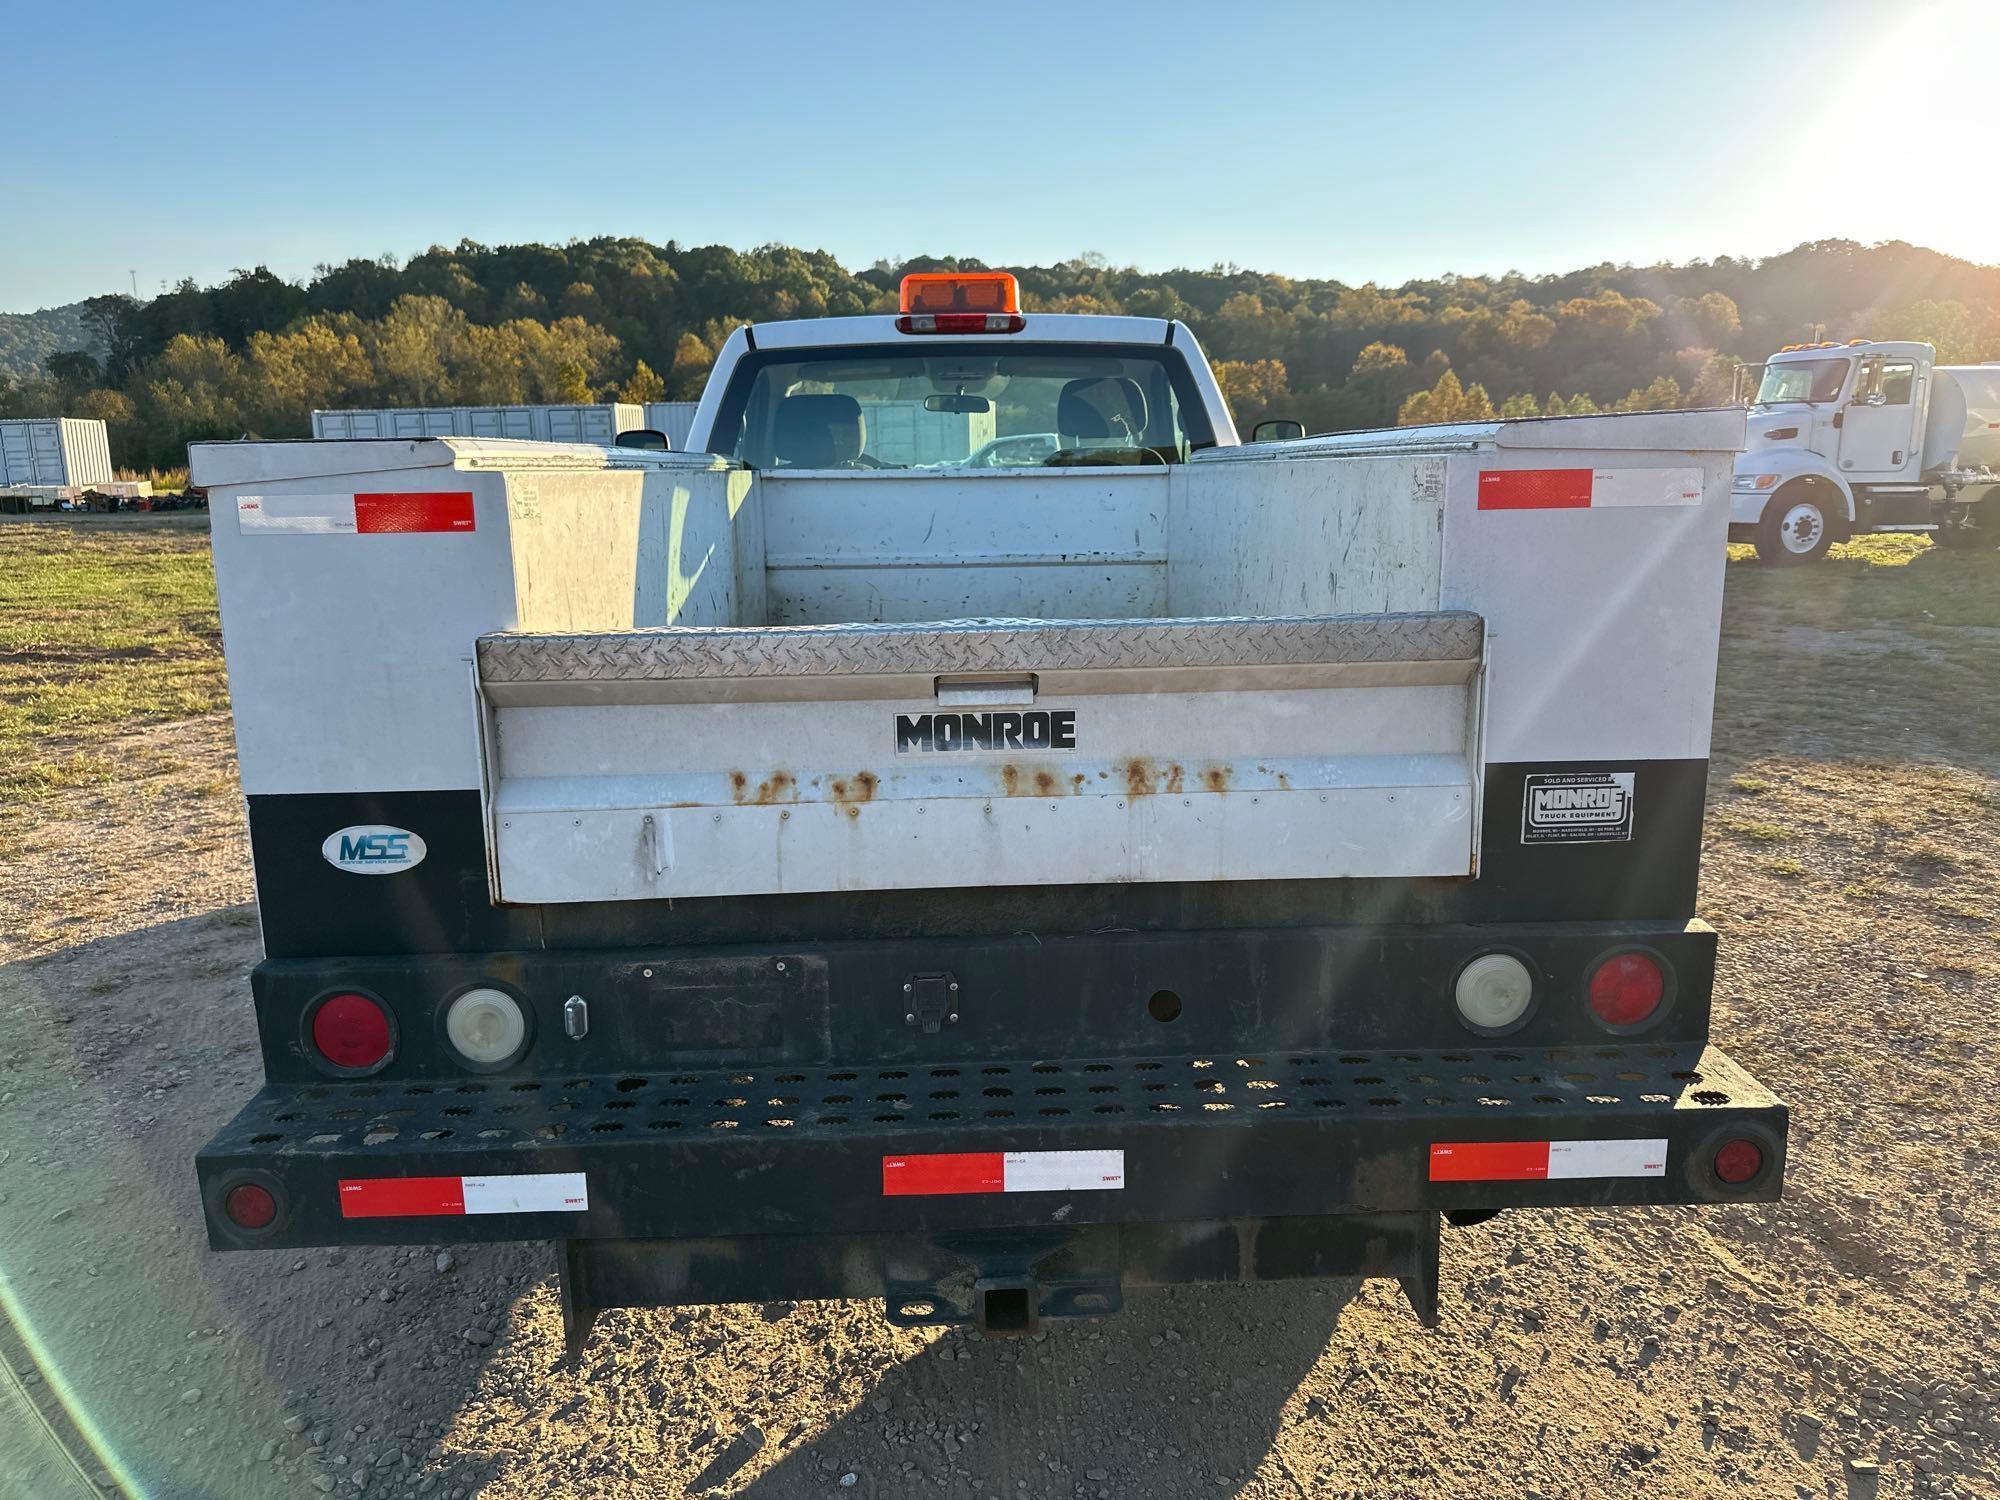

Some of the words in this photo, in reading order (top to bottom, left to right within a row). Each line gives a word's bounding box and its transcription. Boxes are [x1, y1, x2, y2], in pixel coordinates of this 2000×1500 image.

[896, 711, 1076, 753] MONROE
[1534, 788, 1623, 810] MONROE
[1569, 811, 1617, 819] EQUIPMENT
[339, 834, 410, 860] MSS
